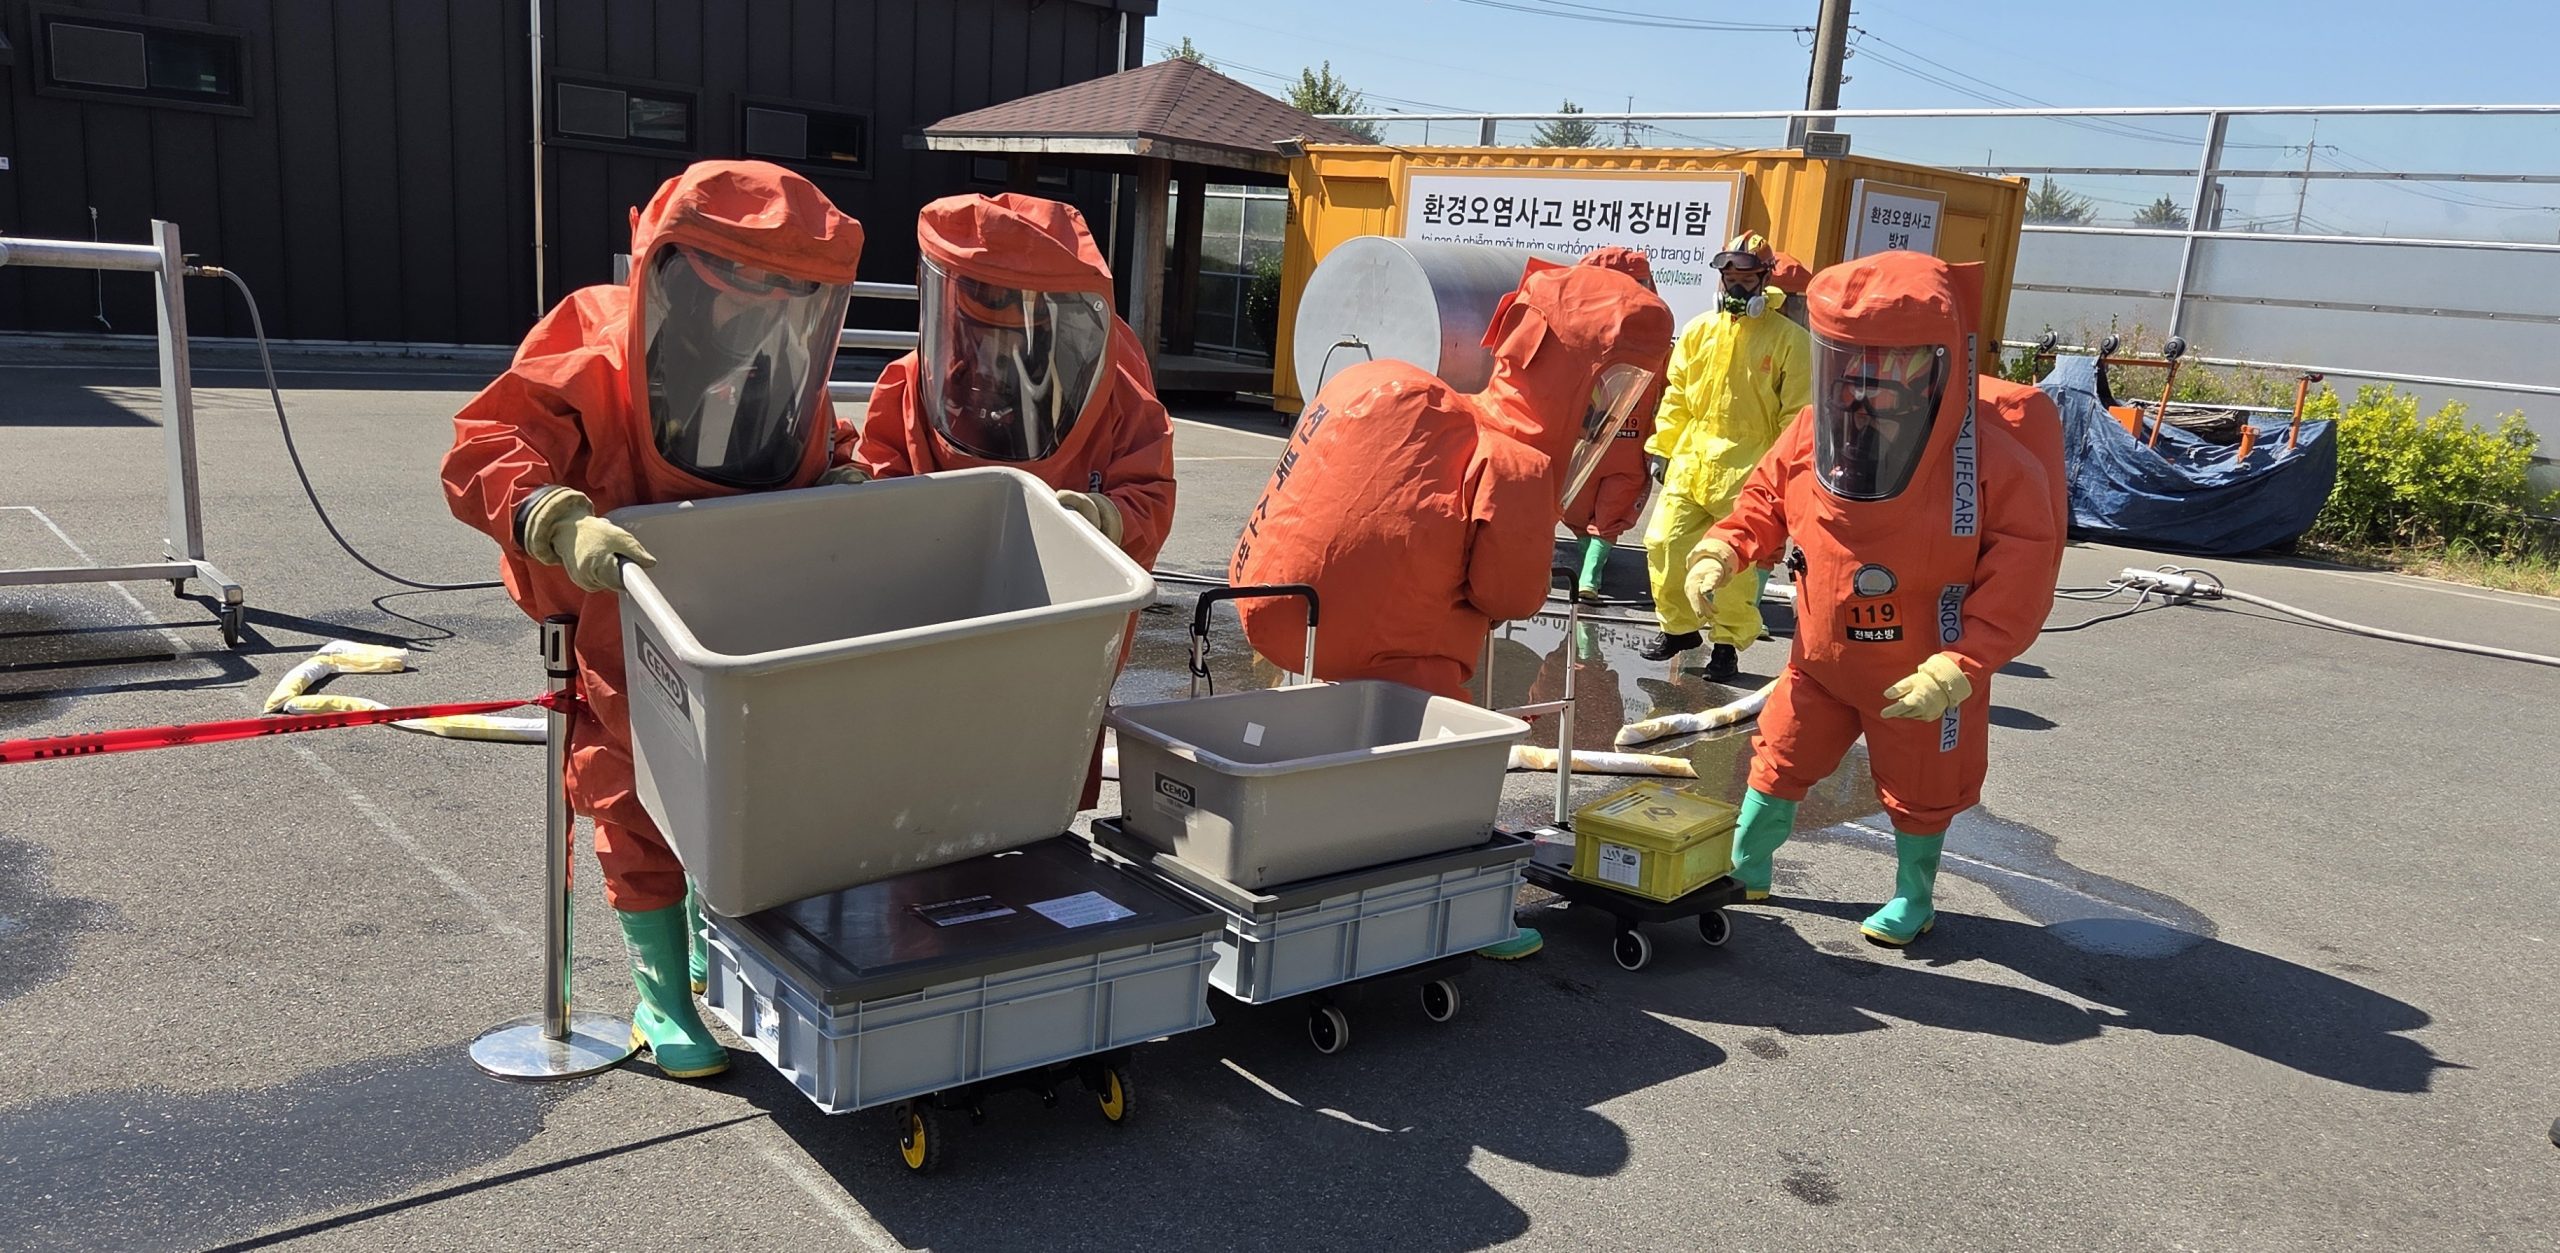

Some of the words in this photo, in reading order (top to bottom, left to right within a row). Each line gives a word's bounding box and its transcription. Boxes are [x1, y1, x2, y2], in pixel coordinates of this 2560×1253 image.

[1423, 194, 1562, 229] 환경오염사고
[1871, 206, 1931, 229] 환경오염사고
[1888, 232, 1909, 251] 방재
[1661, 246, 1691, 264] trang
[1694, 247, 1705, 264] bị
[1954, 447, 1974, 535] LIFECARE
[1851, 603, 1895, 624] 119
[1854, 629, 1895, 640] 전북소방
[646, 648, 681, 700] CEMO
[1163, 782, 1189, 800] CEMO
